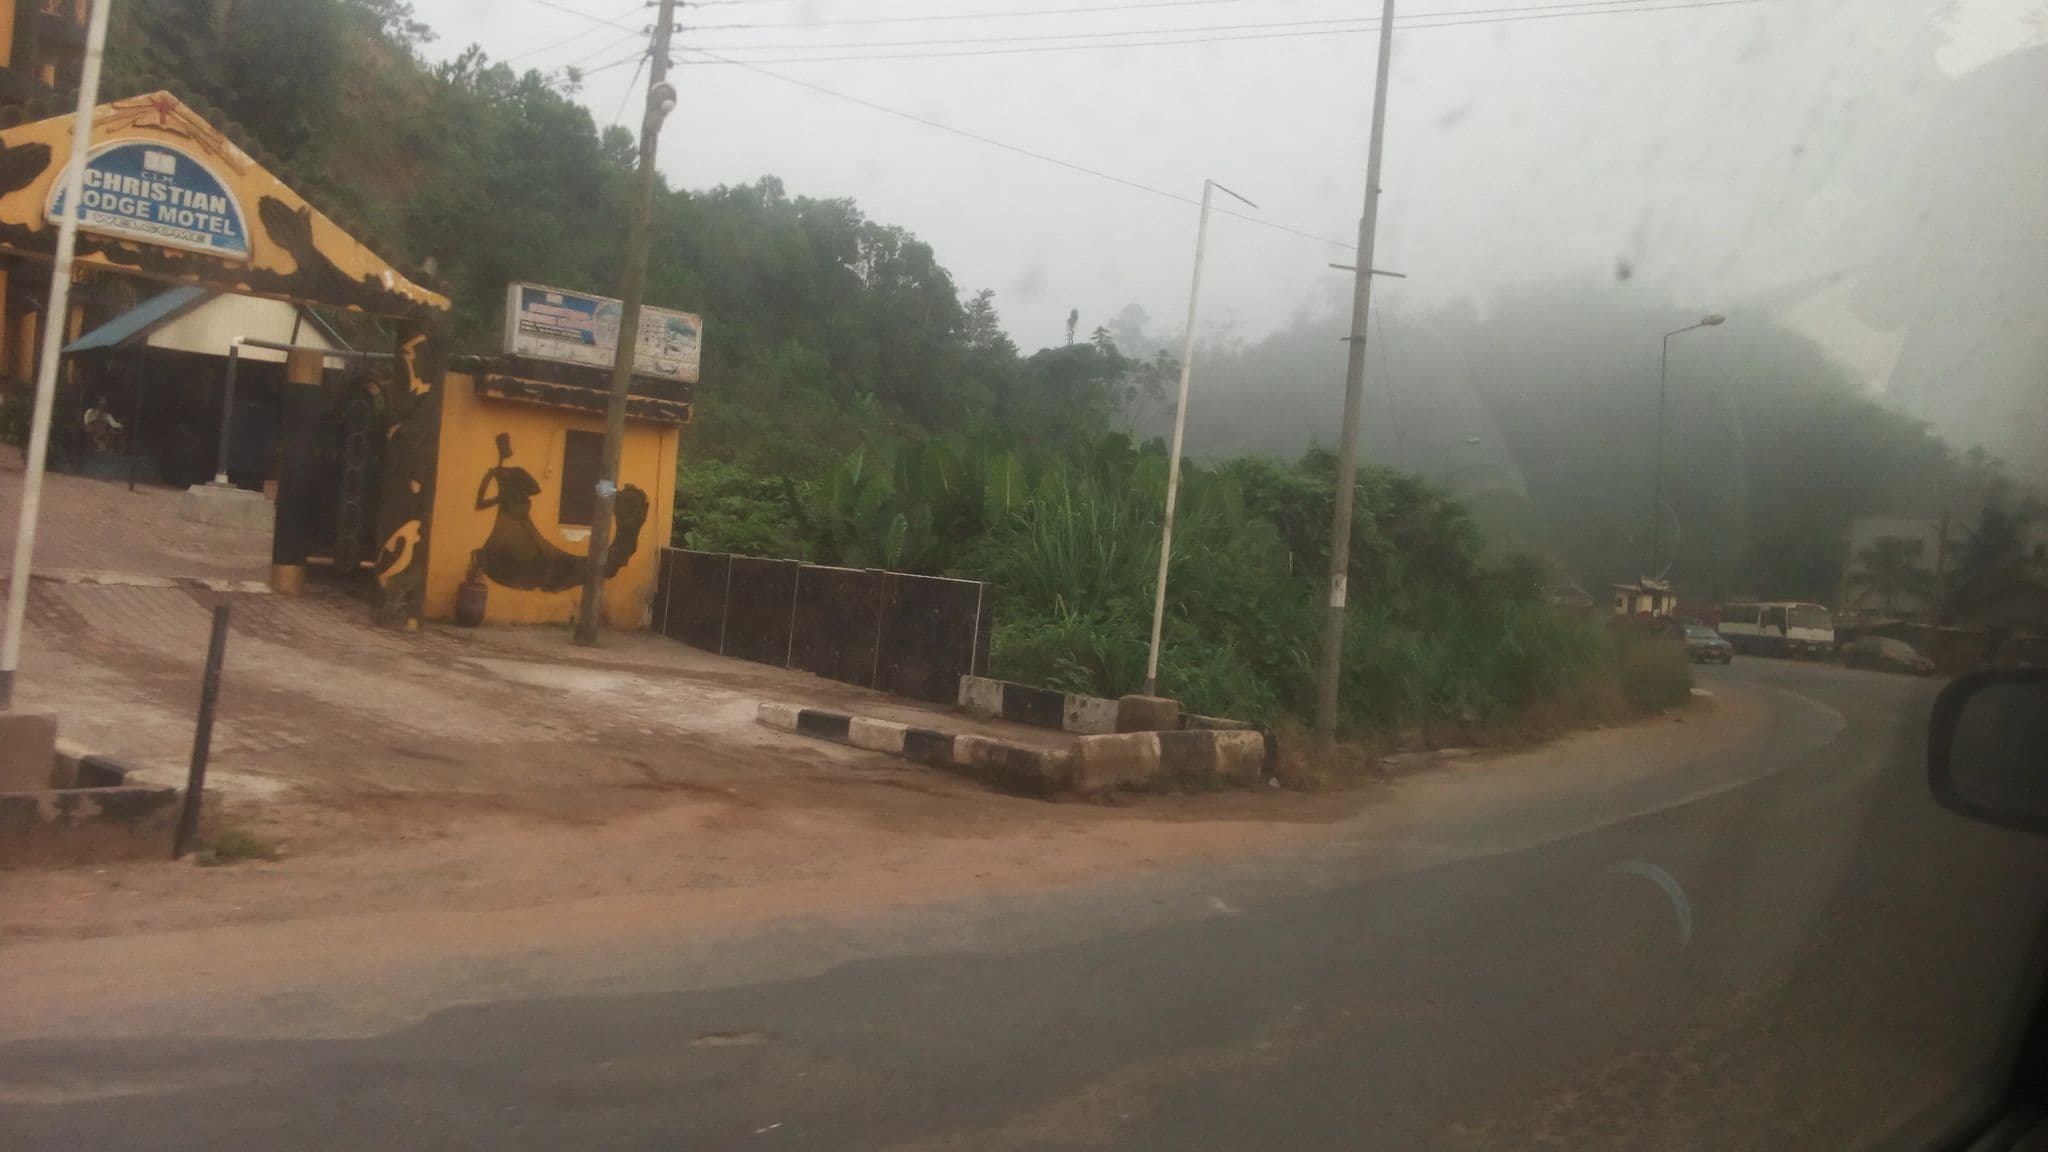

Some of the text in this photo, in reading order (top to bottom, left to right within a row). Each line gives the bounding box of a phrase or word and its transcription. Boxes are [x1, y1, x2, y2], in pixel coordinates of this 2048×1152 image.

[80, 189, 236, 236] ODGE MOTEL
[83, 168, 226, 213] CHRISTIAN
